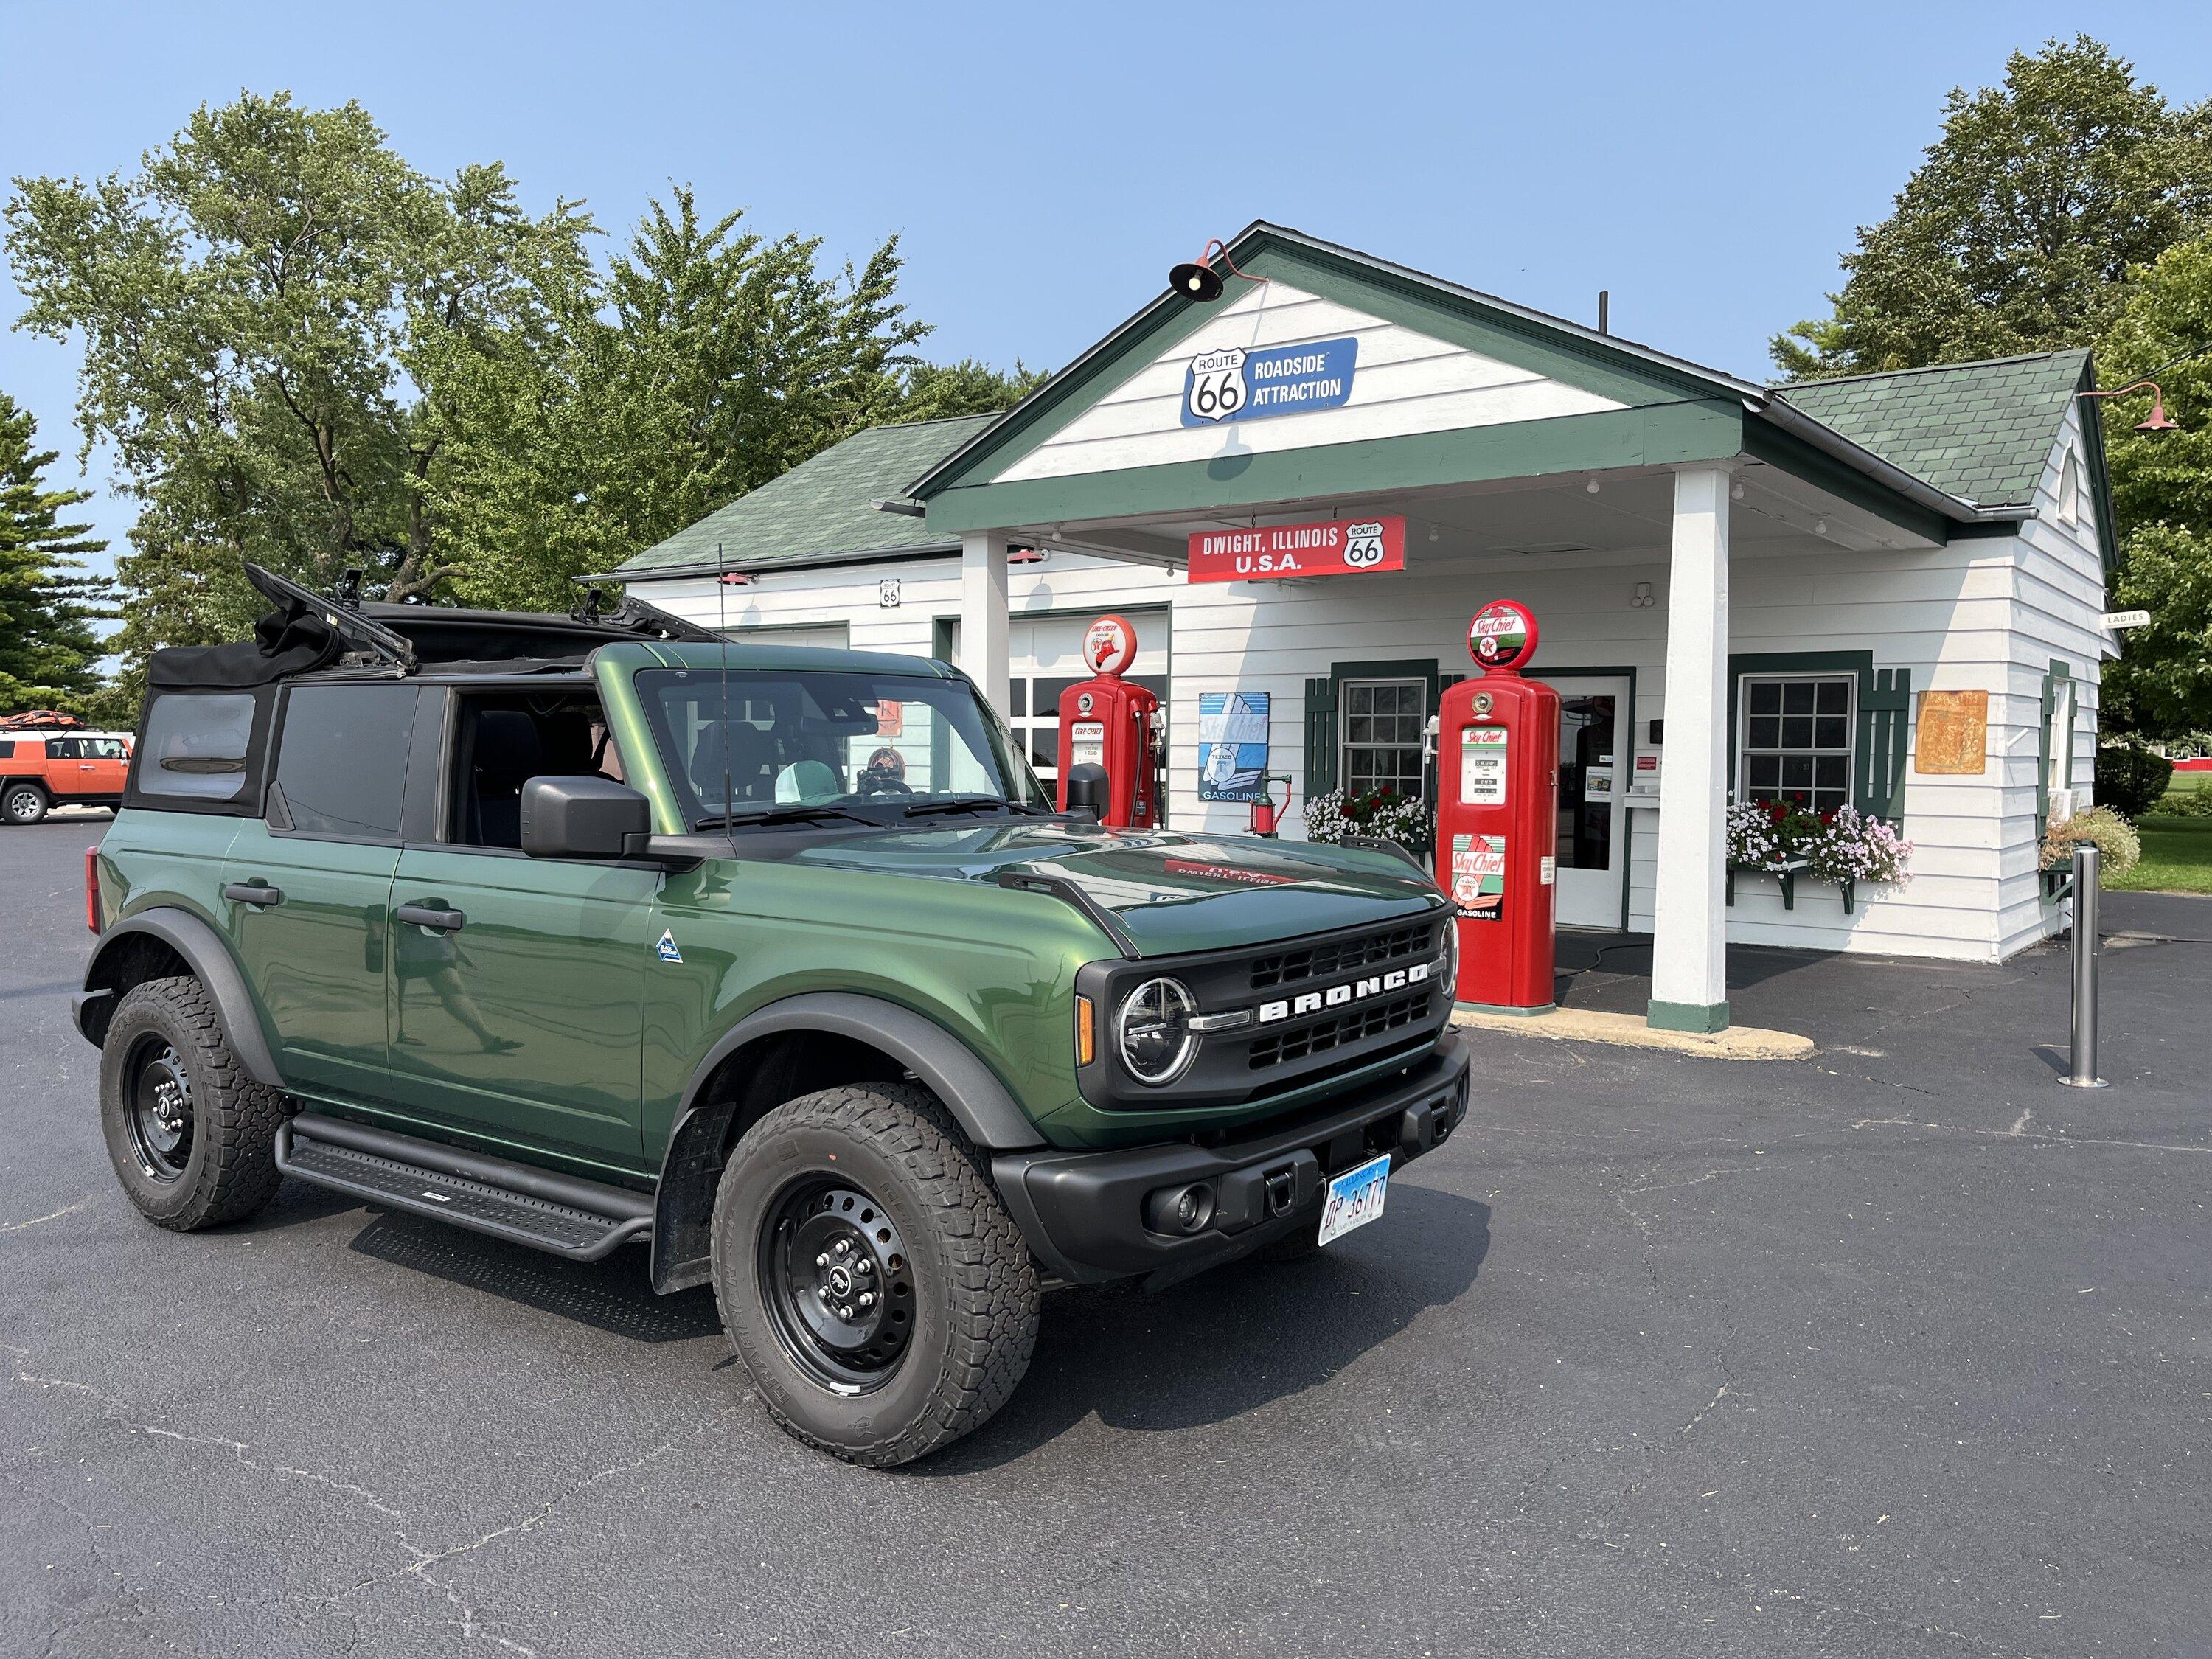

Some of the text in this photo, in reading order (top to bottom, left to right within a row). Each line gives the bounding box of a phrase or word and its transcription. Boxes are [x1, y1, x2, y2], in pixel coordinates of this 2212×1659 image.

[1199, 354, 1238, 370] ROUTE
[1254, 354, 1326, 380] ROADSIDE
[1197, 372, 1238, 413] 66
[1253, 378, 1341, 406] ATTRACTION
[1203, 526, 1338, 555] DWIGHT, ILLINOIS
[1351, 526, 1378, 535] ROUTE
[1349, 539, 1378, 563] 66
[1236, 554, 1302, 574] U.S.A.
[883, 589, 897, 602] 66
[1477, 617, 1516, 635] Sky Chief
[2107, 613, 2143, 624] LADIES
[1467, 731, 1502, 745] Sky Chief
[1453, 852, 1505, 873] Sky Chief
[1457, 909, 1496, 919] GASOLINE
[1259, 963, 1429, 1023] BRONCO
[1345, 1165, 1376, 1186] ILLINOIS
[1324, 1175, 1385, 1230] DP 36777
